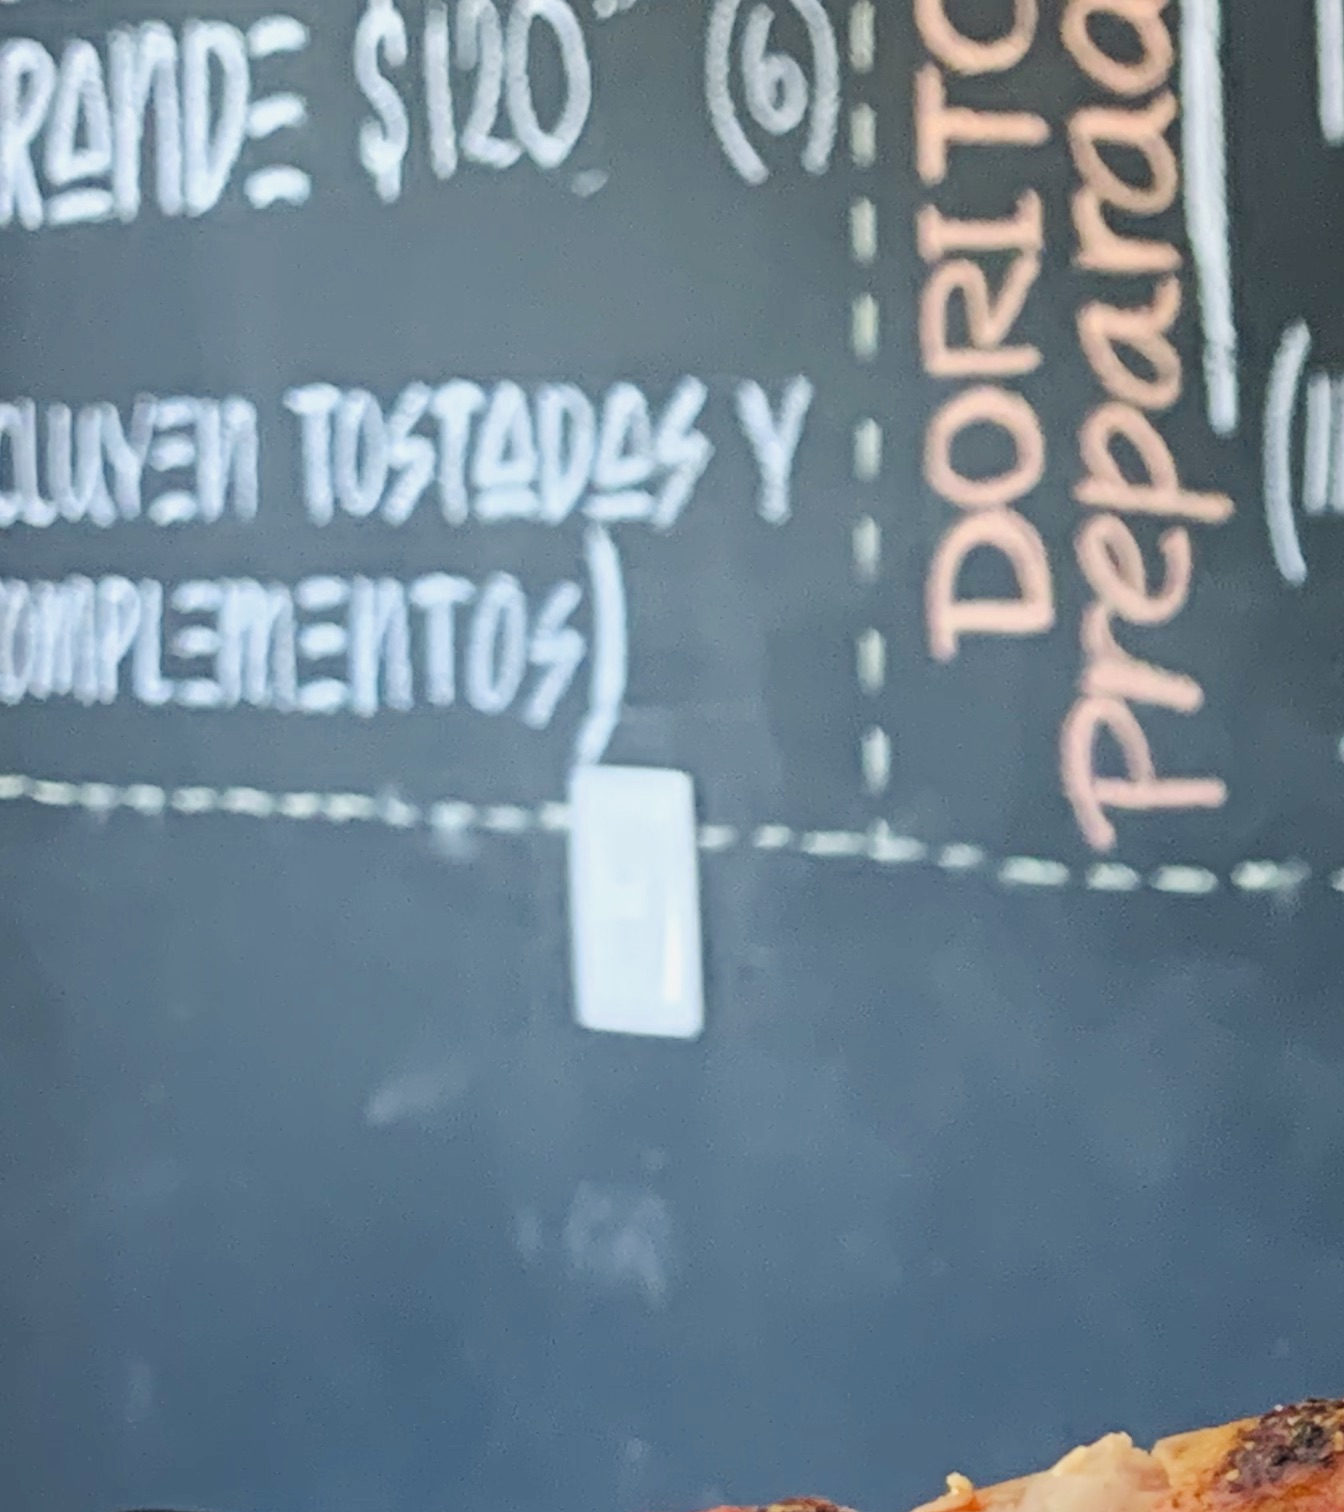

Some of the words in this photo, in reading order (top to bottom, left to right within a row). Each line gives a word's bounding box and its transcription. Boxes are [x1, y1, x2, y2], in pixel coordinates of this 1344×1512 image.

[354, 0, 592, 202] $120
[282, 377, 716, 528] TOSTADAS
[735, 374, 815, 525] Y
